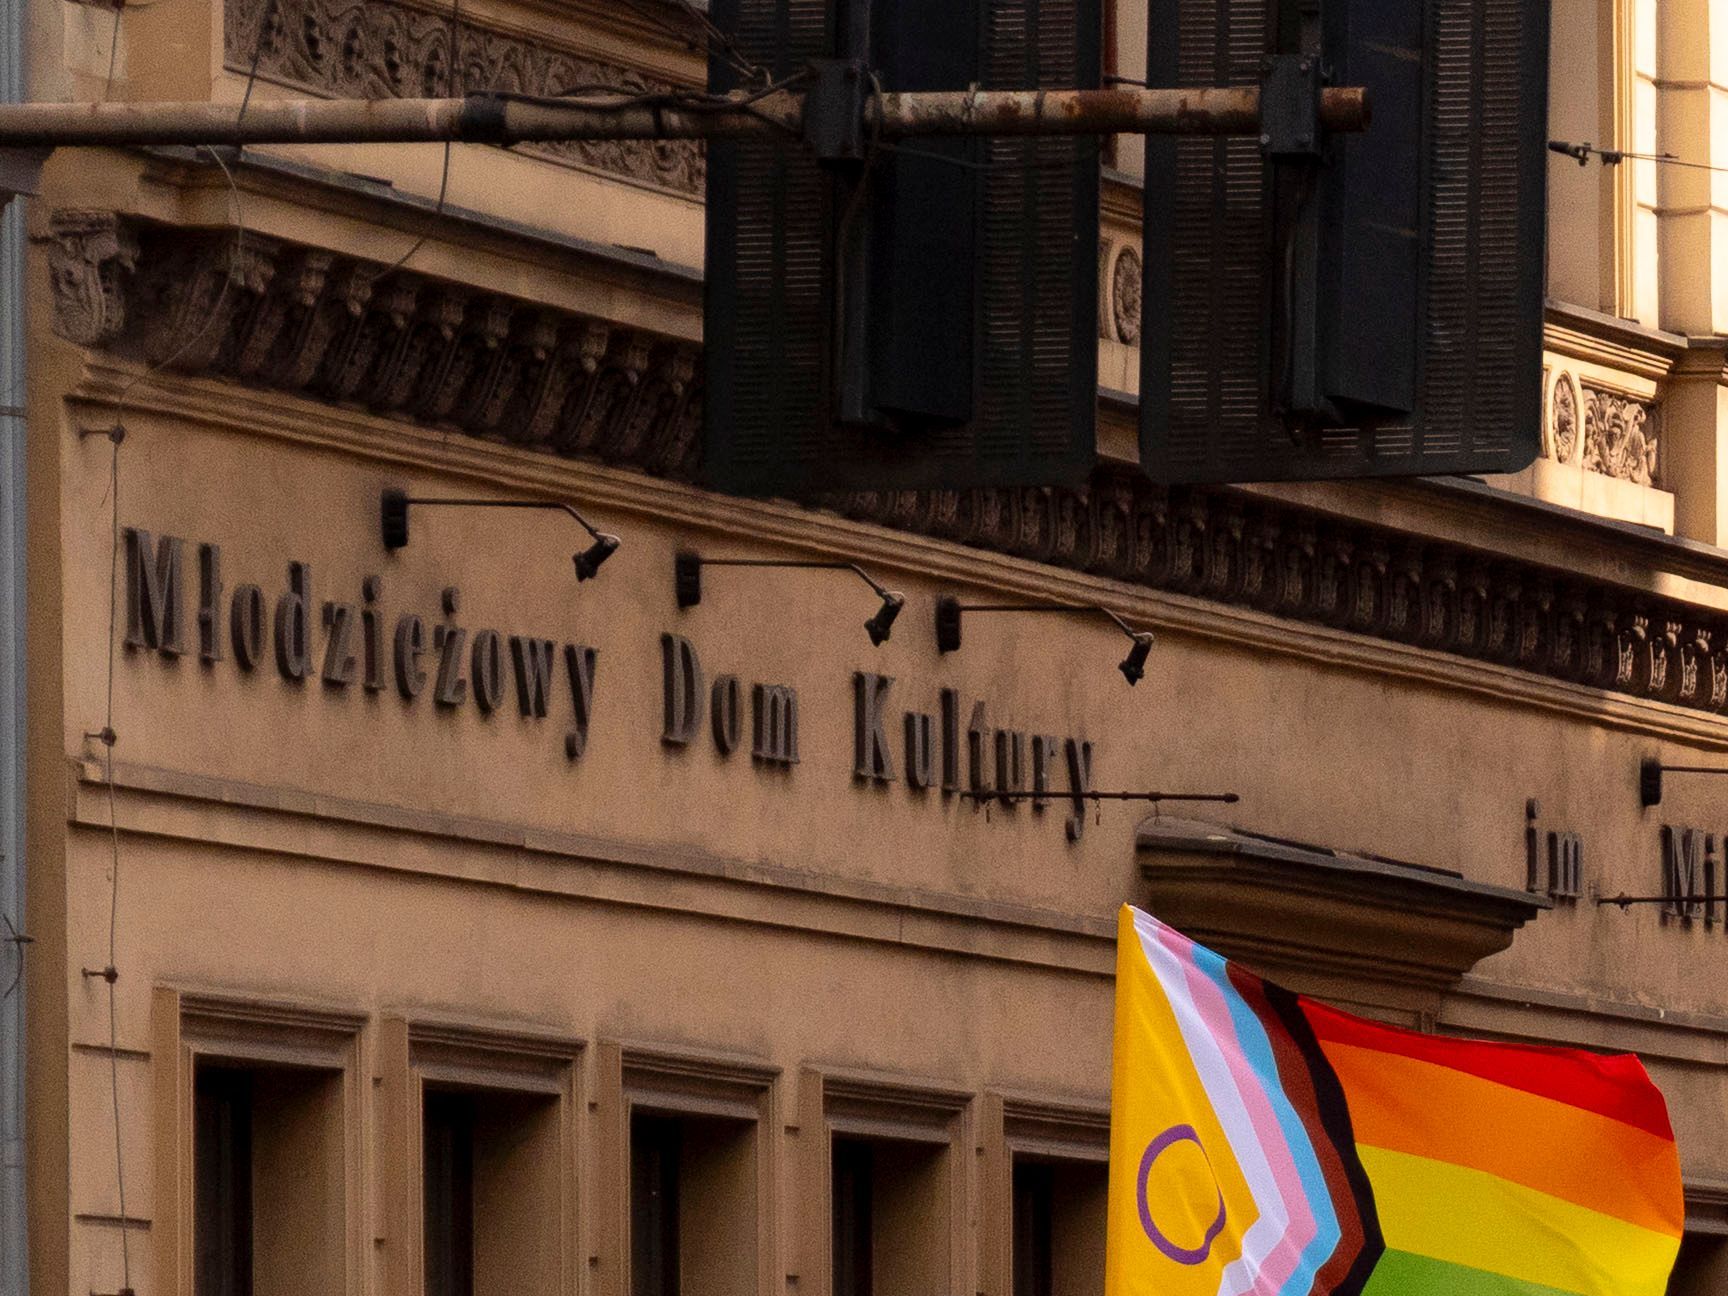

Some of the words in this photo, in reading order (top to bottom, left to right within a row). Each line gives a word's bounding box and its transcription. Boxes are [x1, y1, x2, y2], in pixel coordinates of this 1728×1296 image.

[122, 526, 600, 762] Młodzieżowy
[660, 632, 800, 768] Dom
[852, 670, 1095, 842] Kultury
